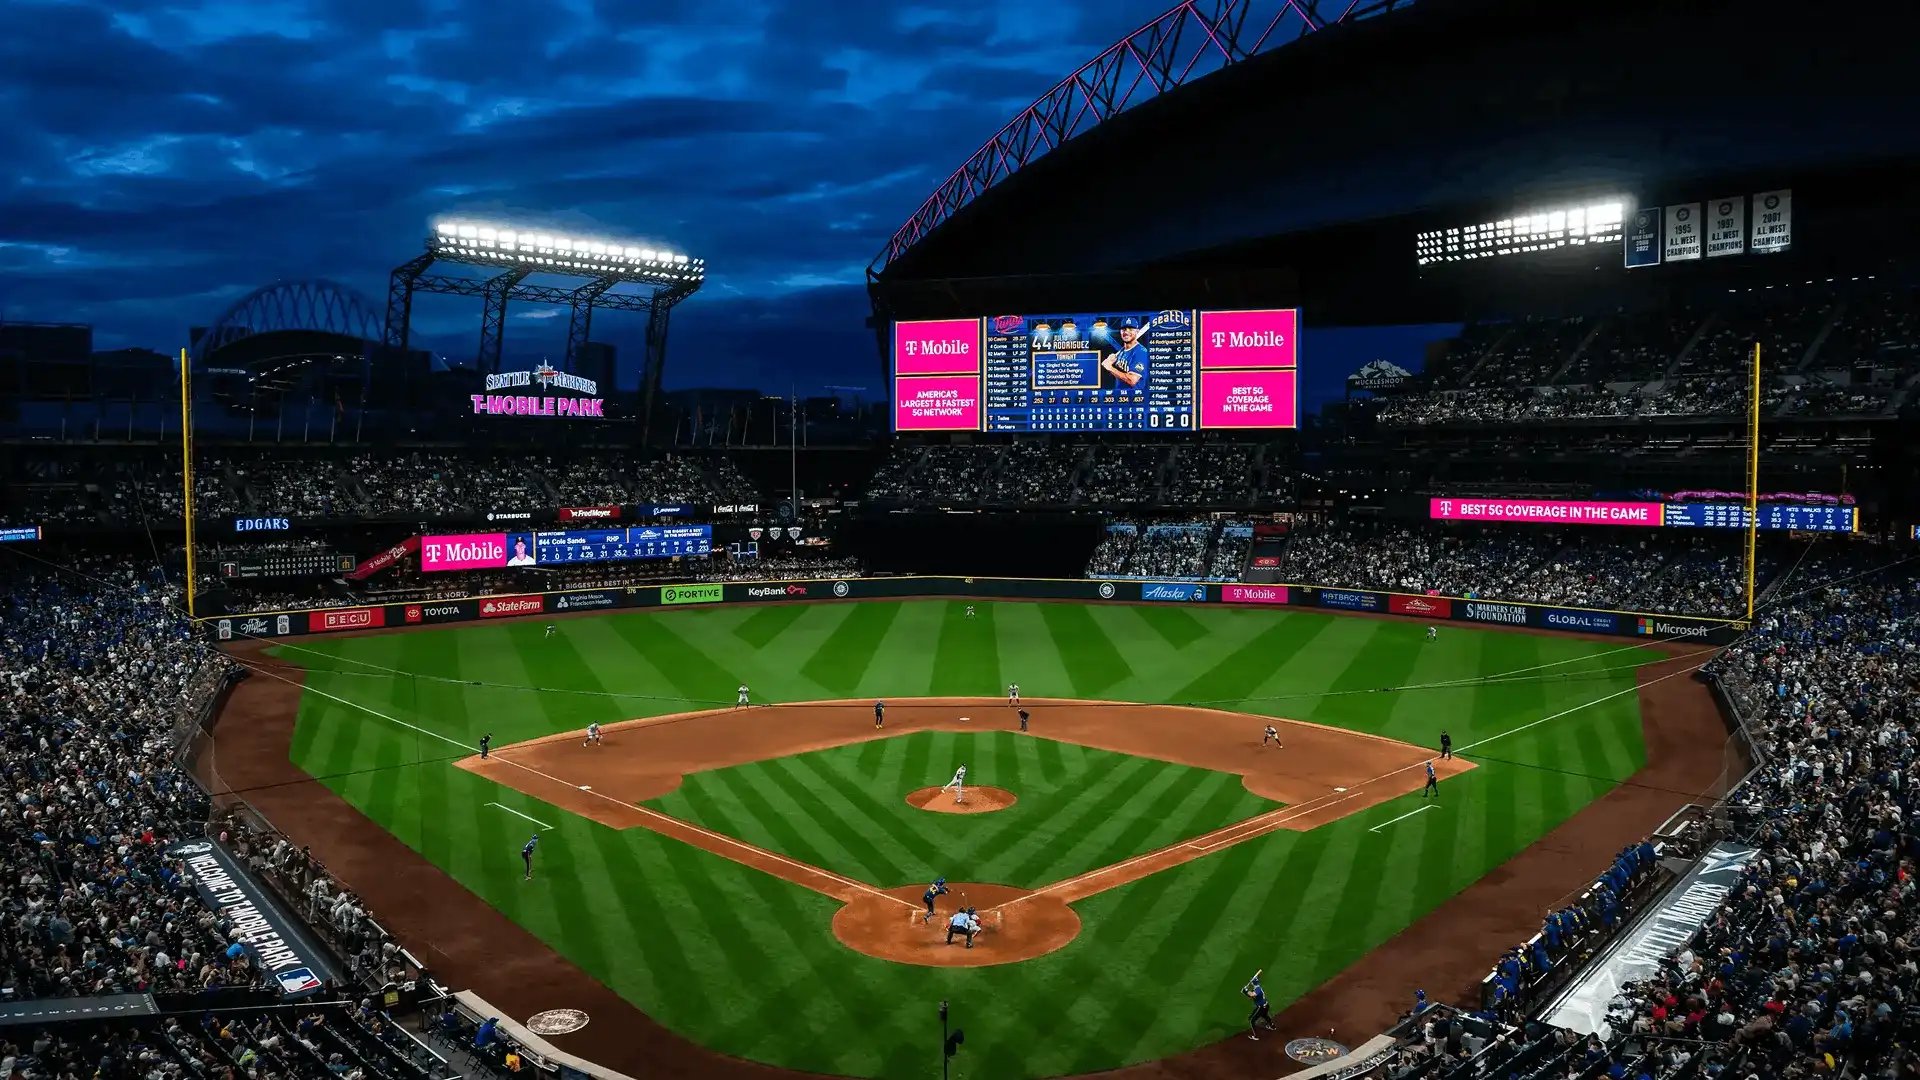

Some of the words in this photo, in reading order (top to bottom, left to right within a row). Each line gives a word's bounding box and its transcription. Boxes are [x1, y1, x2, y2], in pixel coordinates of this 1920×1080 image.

[1675, 224, 1691, 235] 1995
[1717, 218, 1734, 230] 1997
[1769, 224, 1786, 234] WEST
[1681, 236, 1696, 245] WEST
[1723, 230, 1739, 240] WEST
[1753, 235, 1790, 246] CHAMPIONS
[1667, 246, 1700, 257] CHAMPIONS
[1708, 240, 1743, 252] CHAMPIONS
[1032, 336, 1051, 350] 44
[1229, 331, 1284, 347] Mobile
[921, 340, 969, 355] Mobile
[1053, 341, 1089, 349] RODRIGUEZ
[486, 371, 530, 391] SEATTLE
[553, 371, 597, 395] MARINERS
[1355, 378, 1404, 386] MUCKLESHOOT
[917, 390, 958, 398] AMERICA'S
[1232, 387, 1252, 395] BEST
[1252, 387, 1263, 395] 5G
[900, 400, 934, 408] LARGEST
[942, 399, 975, 407] FASTEST
[1226, 395, 1269, 403] COVERAGE
[471, 394, 556, 416] T-MOBILE
[558, 397, 604, 417] PARK
[1223, 404, 1231, 412] IN
[1233, 404, 1248, 412] THE
[1249, 404, 1273, 412] GAME
[924, 408, 963, 416] NETWORK
[1151, 414, 1158, 428] 0
[1166, 414, 1174, 428] 2
[1181, 414, 1189, 428] 0
[1461, 503, 1487, 515] BEST
[1489, 504, 1503, 516] 5G
[1505, 504, 1567, 518] COVERAGE
[1570, 506, 1582, 518] IN
[1584, 507, 1608, 519] THE
[1610, 507, 1648, 521] GAME
[445, 542, 503, 562] Mobile
[374, 555, 391, 566] Mobile
[565, 581, 595, 589] BIGGEST
[678, 589, 720, 599] FORTIVE
[749, 587, 786, 597] KeyBank
[1145, 586, 1185, 599] Alaska
[1244, 589, 1276, 600] Mobile
[1322, 592, 1360, 602] HATBACK
[424, 606, 460, 616] TOYOTA
[1477, 604, 1508, 613] MARINERS
[1510, 606, 1526, 615] CARE
[328, 614, 368, 625] BECU
[1476, 610, 1526, 624] FOUNDATION
[1548, 614, 1591, 626] GLOBAL
[1656, 623, 1708, 637] Microsoft
[187, 853, 236, 893] WELCOME
[214, 888, 246, 904] TO
[224, 899, 279, 943] T-MOBILE
[253, 939, 302, 971] PARK
